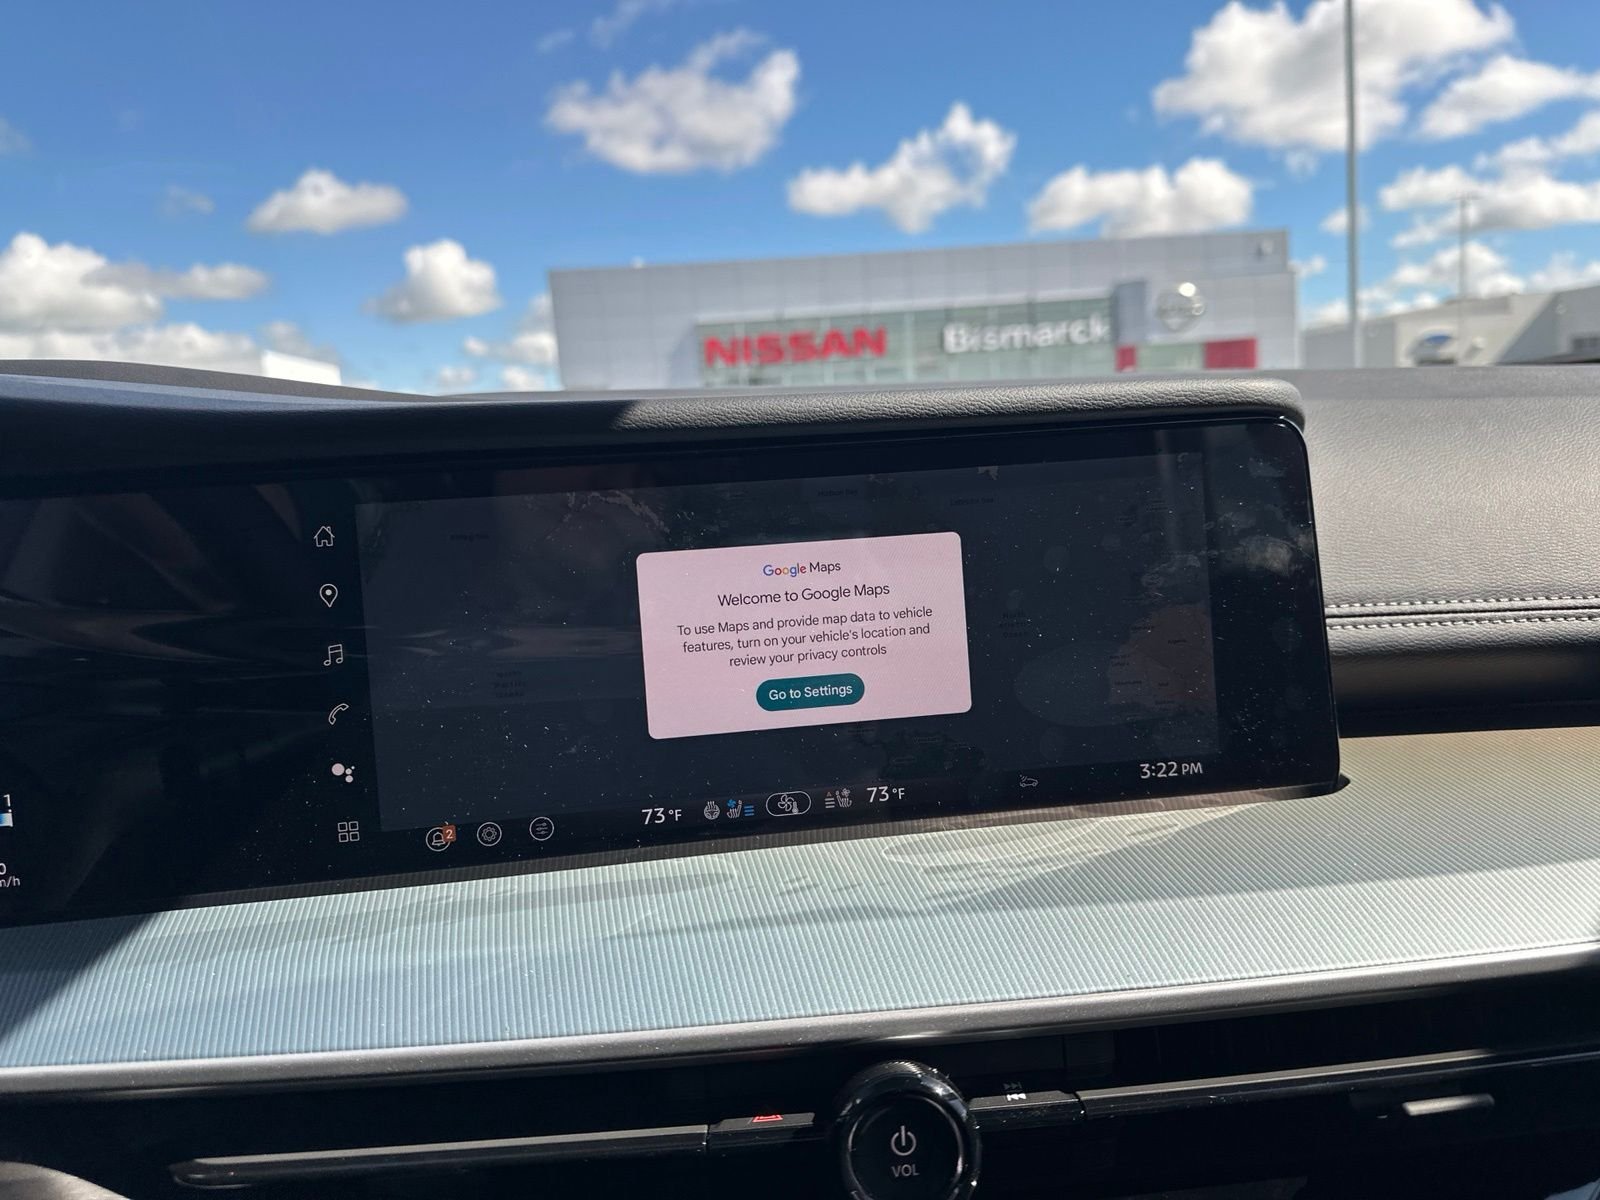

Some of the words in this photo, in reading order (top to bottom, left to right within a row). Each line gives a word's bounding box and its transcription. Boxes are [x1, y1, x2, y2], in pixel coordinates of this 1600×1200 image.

[703, 325, 887, 368] NISSAN
[942, 313, 1111, 354] Bismarck
[762, 562, 807, 578] Google
[809, 560, 842, 576] Maps
[717, 589, 782, 607] Welcome
[784, 590, 799, 602] to
[801, 585, 851, 602] Google
[854, 582, 891, 600] Maps
[677, 624, 692, 636] To
[694, 624, 716, 636] use
[718, 620, 750, 636] Maps
[752, 617, 774, 631] and
[777, 613, 820, 632] provide
[822, 612, 848, 628] map
[850, 611, 876, 624] data
[879, 609, 891, 621] to
[893, 605, 933, 620] vehicle
[683, 638, 735, 654] features,
[737, 635, 762, 649] turn
[764, 636, 779, 648] on
[781, 633, 807, 650] your
[809, 629, 859, 644] vehicle's
[861, 624, 907, 640] location
[909, 622, 931, 636] and
[729, 652, 767, 668] review
[769, 650, 795, 668] your
[797, 645, 838, 665] privacy
[841, 642, 888, 659] controls
[768, 687, 787, 702] Go
[789, 688, 801, 700] to
[804, 682, 853, 698] Settings
[1140, 761, 1178, 779] 3:22
[1181, 762, 1203, 775] PM
[444, 828, 455, 842] 2
[891, 1163, 920, 1178] VOL
